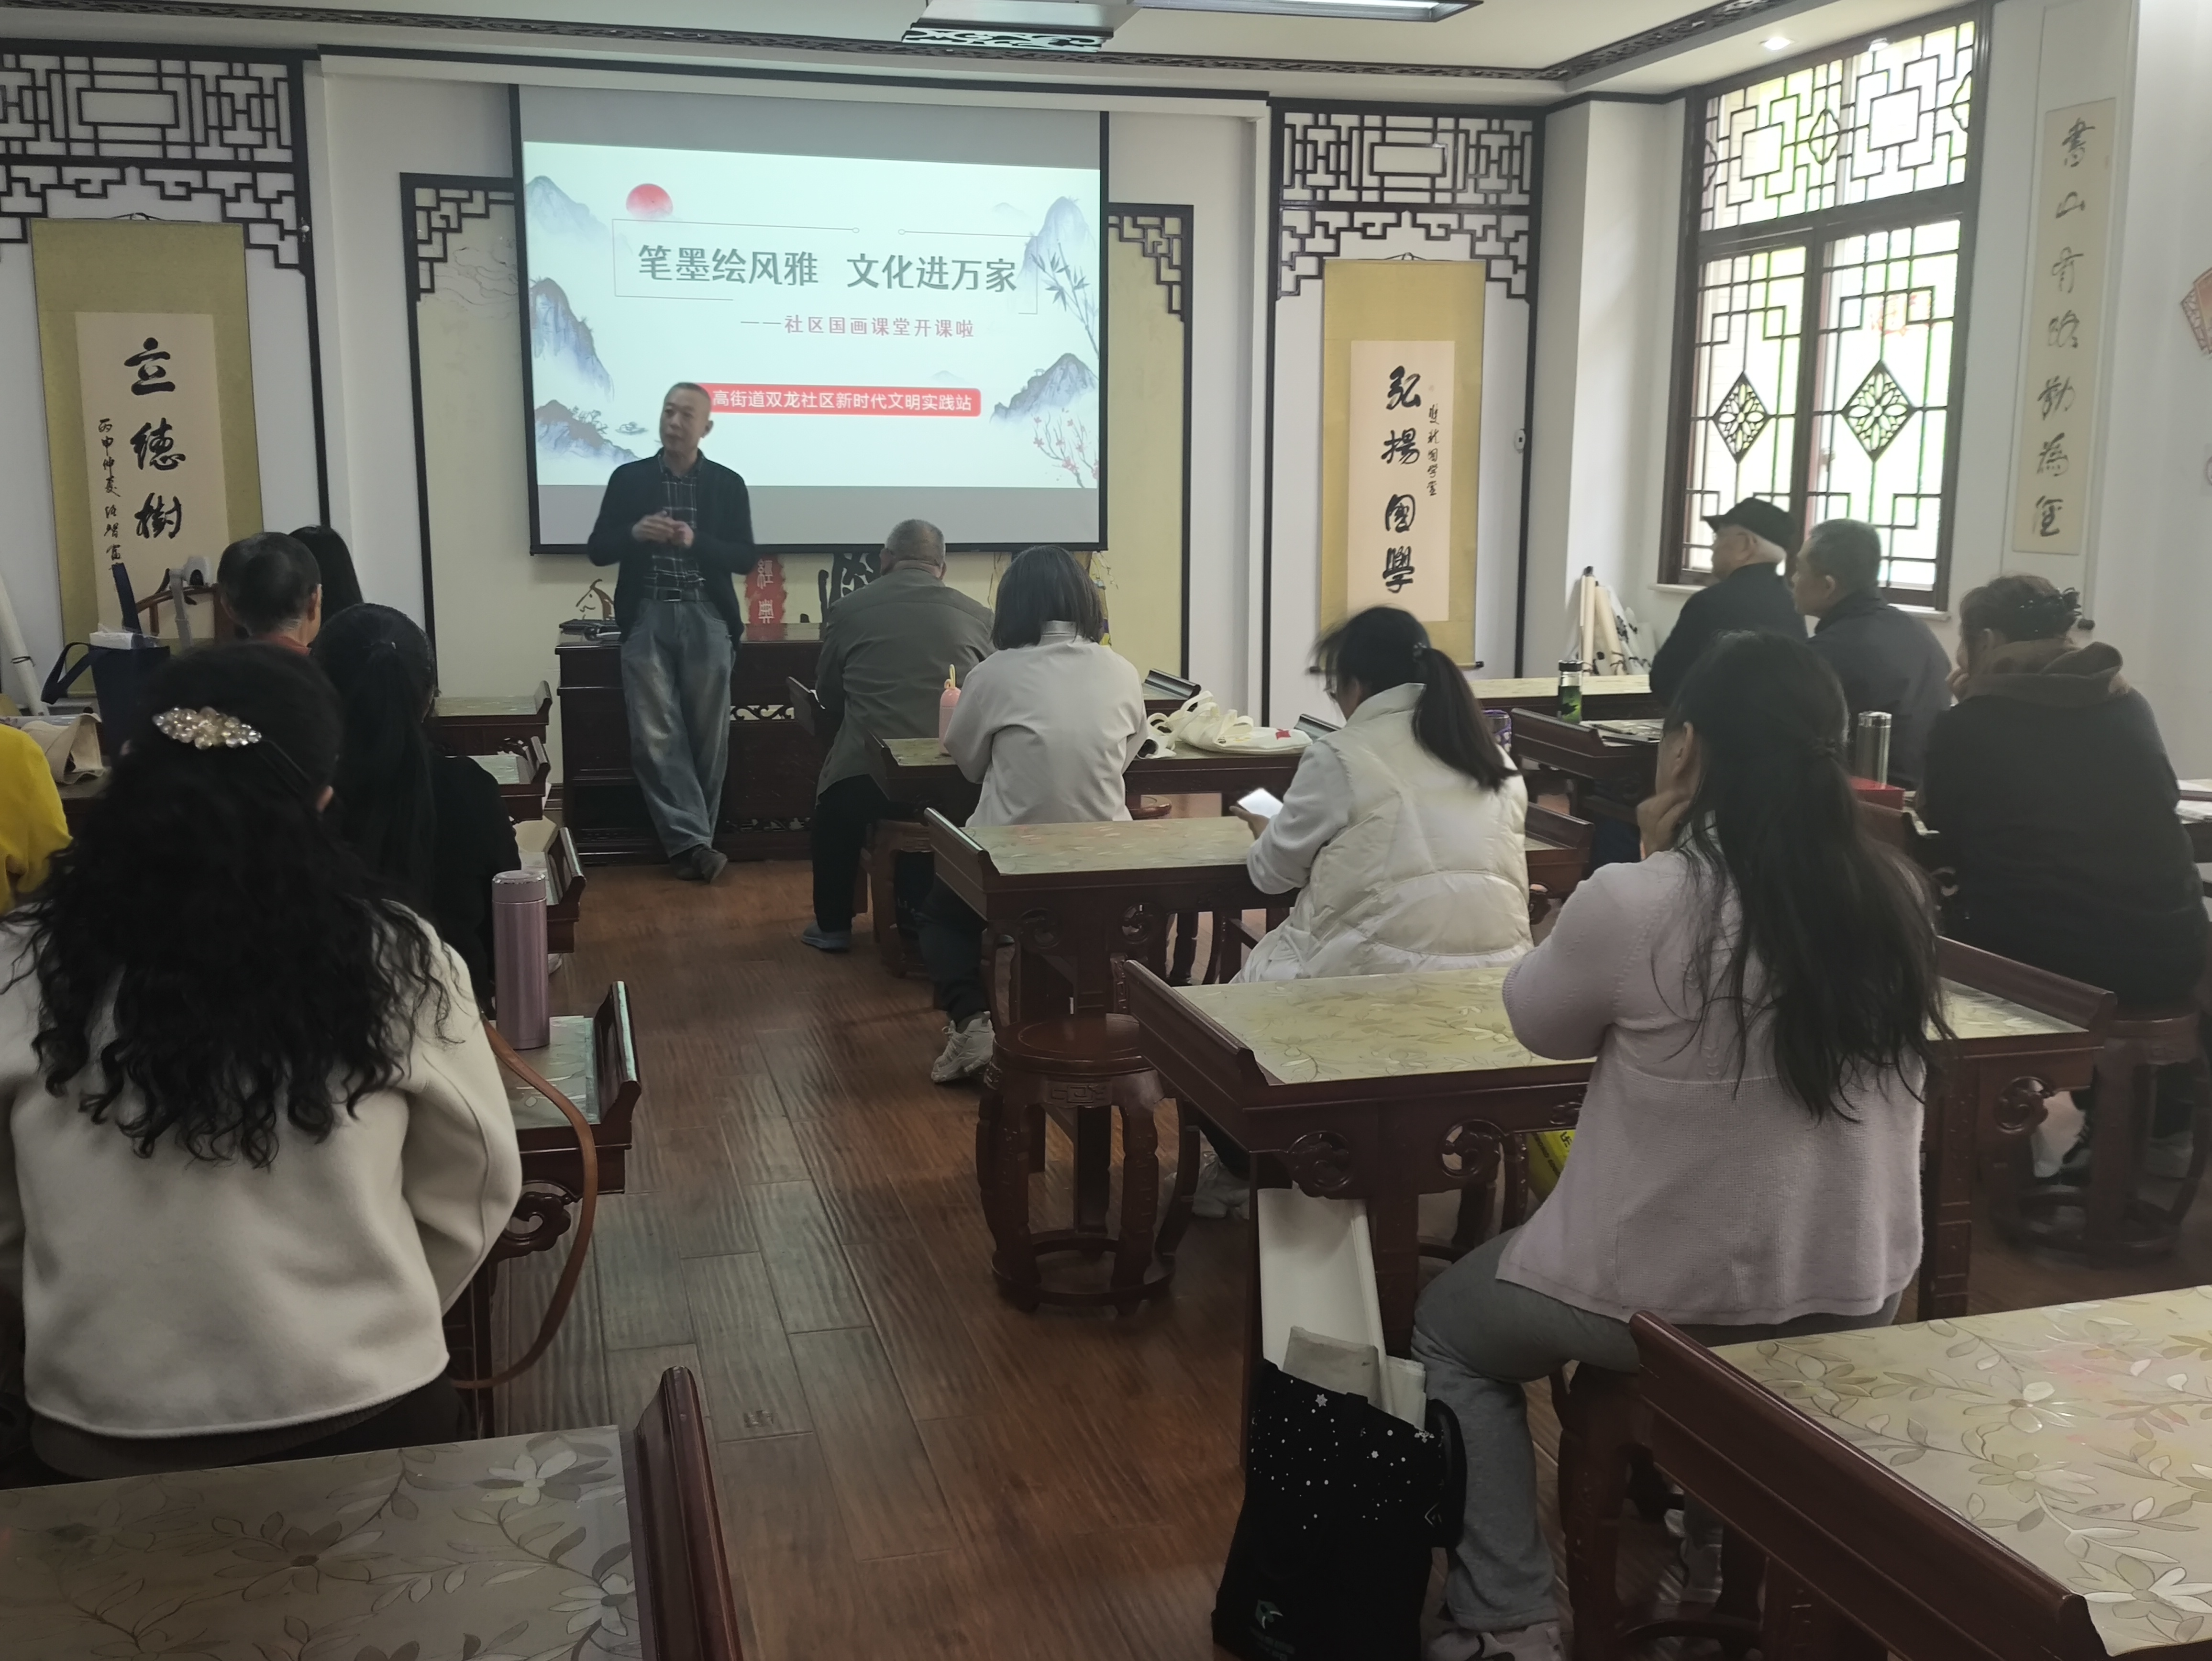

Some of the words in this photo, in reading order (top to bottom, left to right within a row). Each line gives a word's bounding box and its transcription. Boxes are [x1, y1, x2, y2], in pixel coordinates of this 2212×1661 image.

[639, 245, 818, 286] 笔墨绘风雅
[847, 253, 1017, 292] 文化进万家
[712, 390, 973, 411] 高街道双龙社区新时代文明实践站
